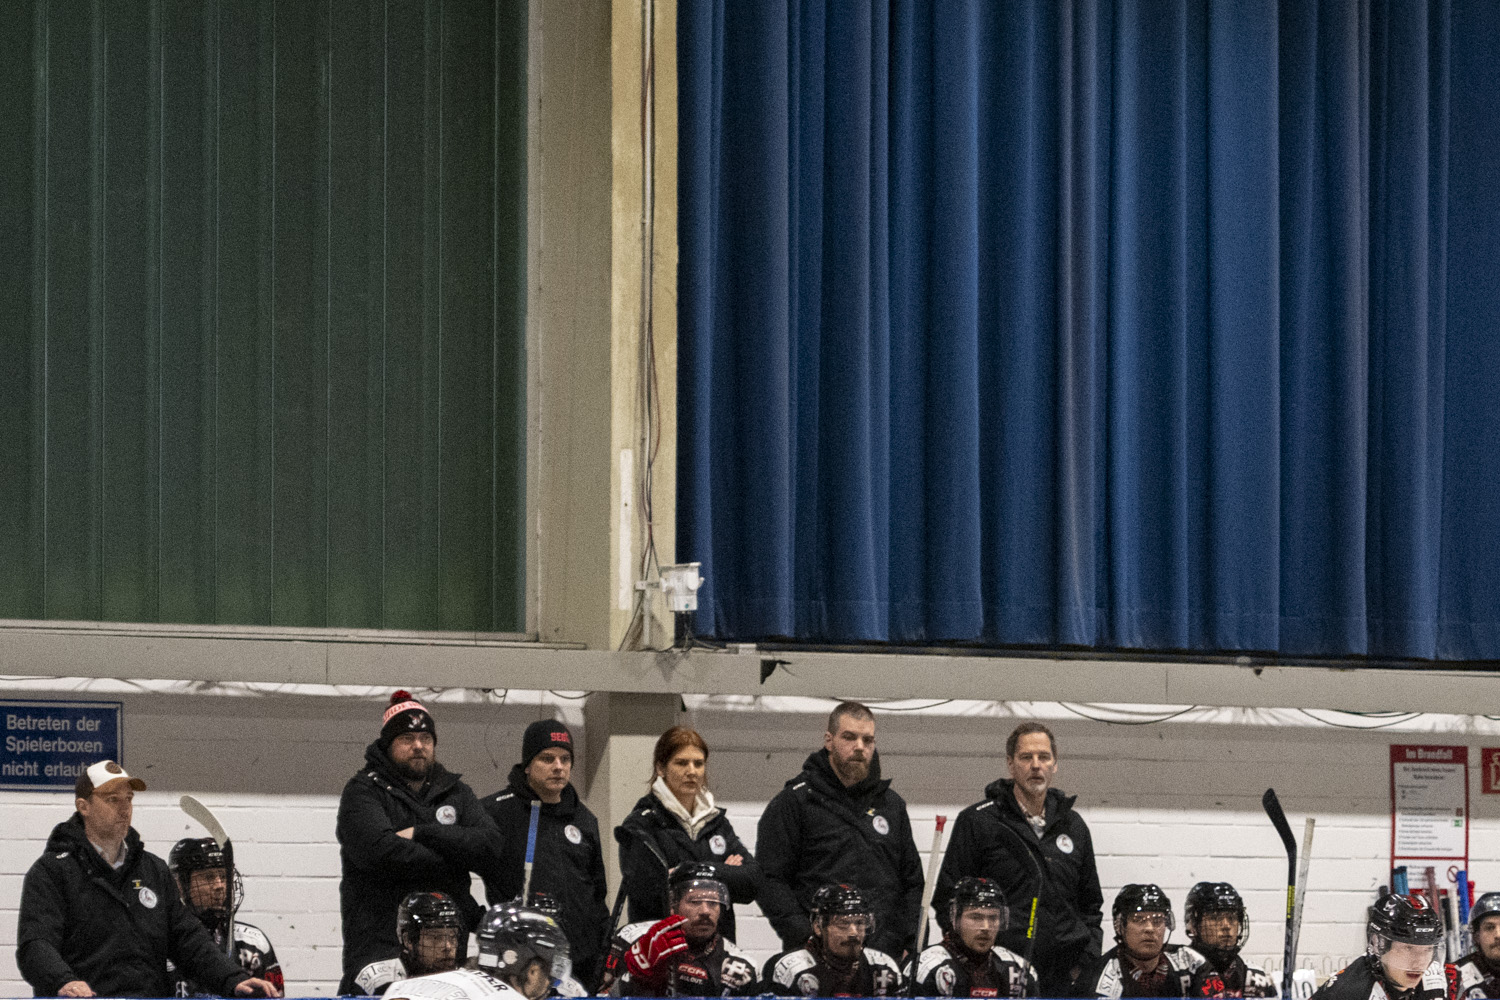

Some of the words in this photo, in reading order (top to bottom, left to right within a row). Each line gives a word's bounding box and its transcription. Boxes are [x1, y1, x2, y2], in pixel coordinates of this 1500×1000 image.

[6, 714, 71, 731] Betreten
[76, 716, 102, 732] der
[5, 736, 103, 755] Spielerboxen
[1, 761, 39, 777] nicht
[44, 761, 93, 777] erlau
